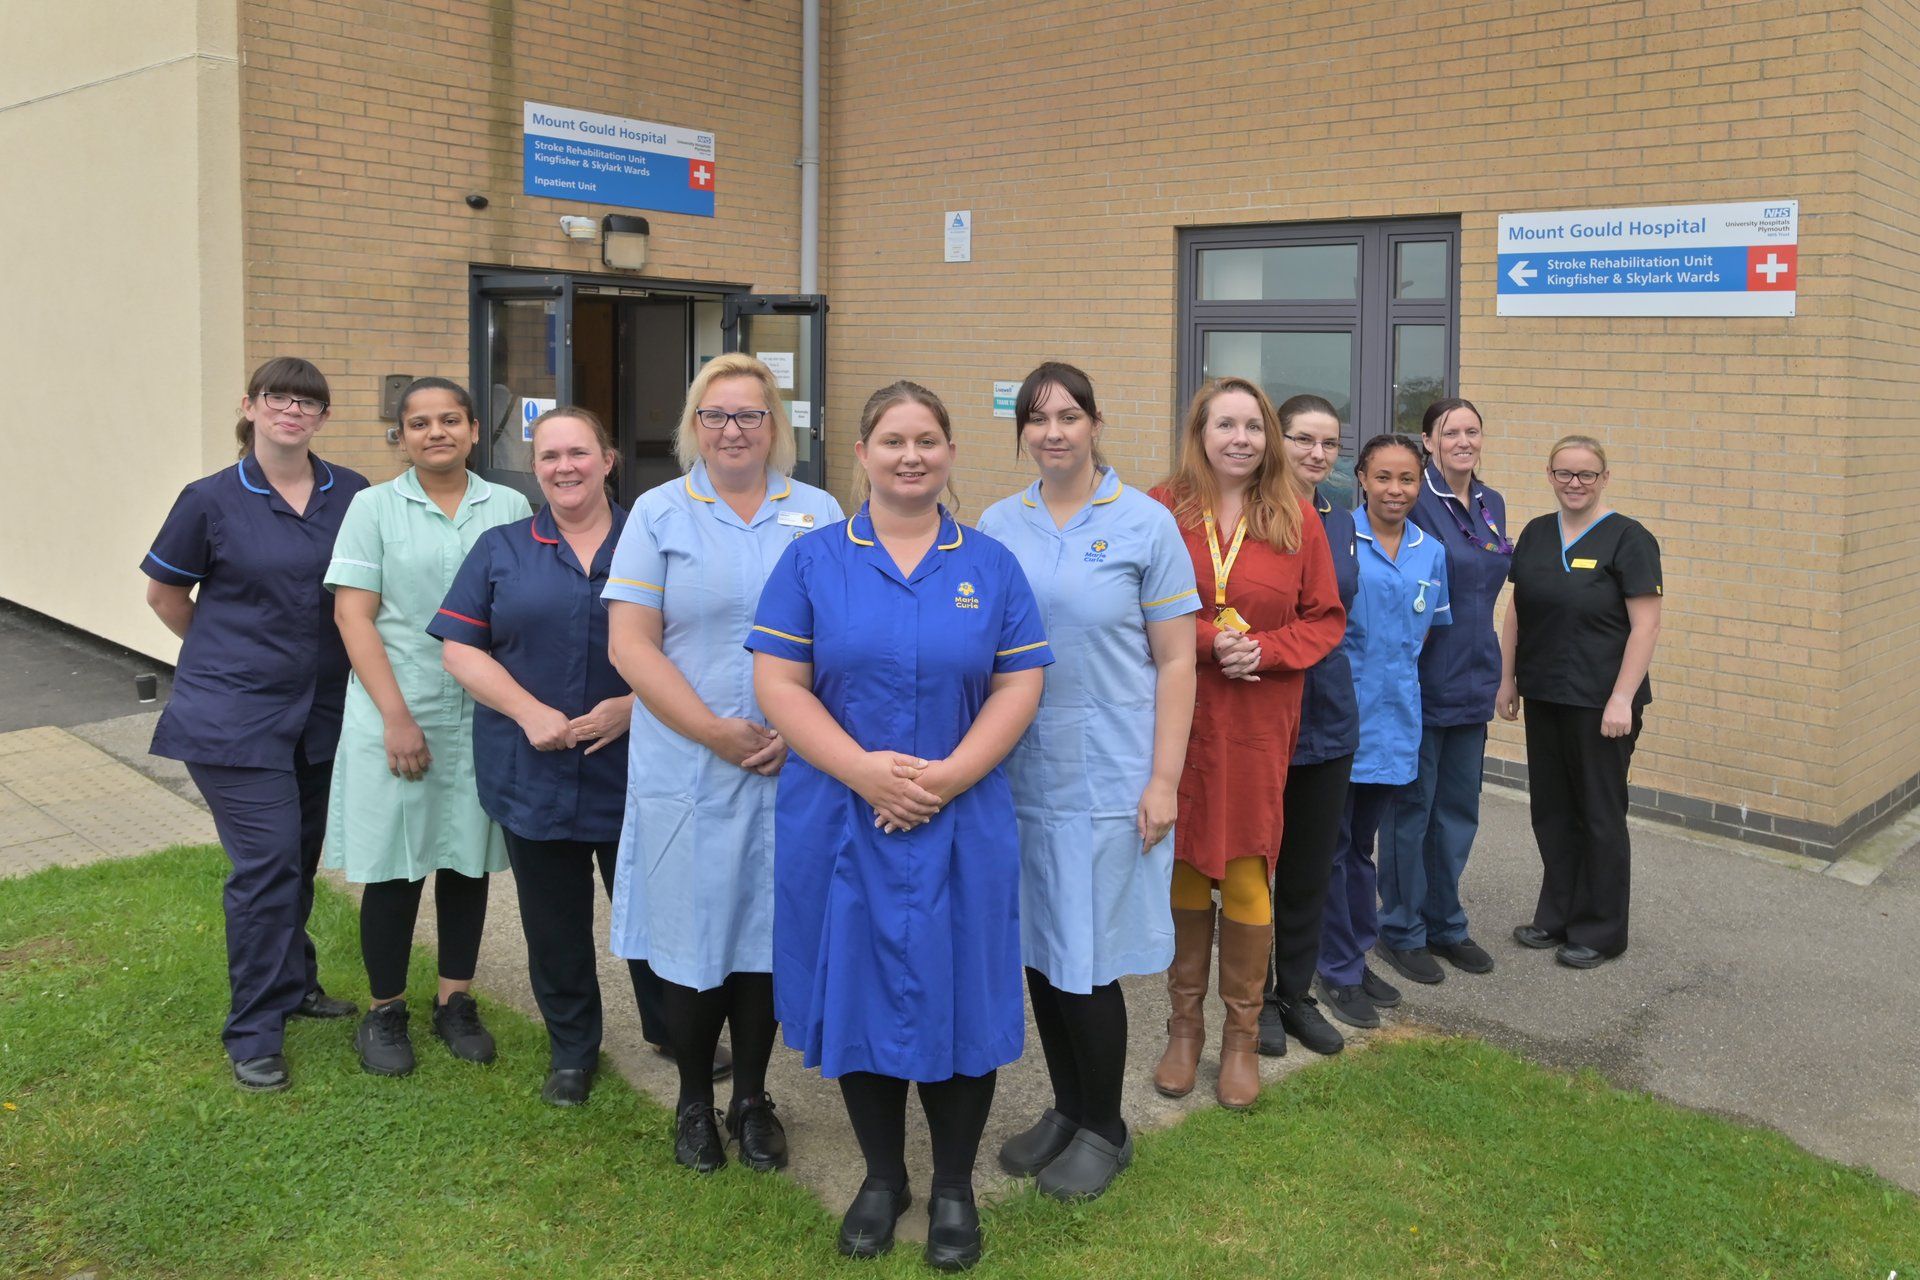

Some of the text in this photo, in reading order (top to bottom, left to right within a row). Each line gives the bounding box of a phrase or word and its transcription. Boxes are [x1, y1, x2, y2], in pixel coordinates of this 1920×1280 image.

[532, 113, 667, 144] Mount Gould Hospital
[535, 141, 646, 165] Stroke Rehabilitation Unit
[535, 153, 650, 176] Kingfisher & Skylark Wards
[535, 175, 597, 191] Inpatient Unit
[1764, 208, 1790, 218] NHS
[1509, 217, 1706, 241] Mount Gould Hospital
[1725, 219, 1790, 228] University Hospitals
[1547, 254, 1713, 270] Stroke Rehabilitation Unit
[1547, 271, 1720, 287] Kingfisher & Skylark Wards
